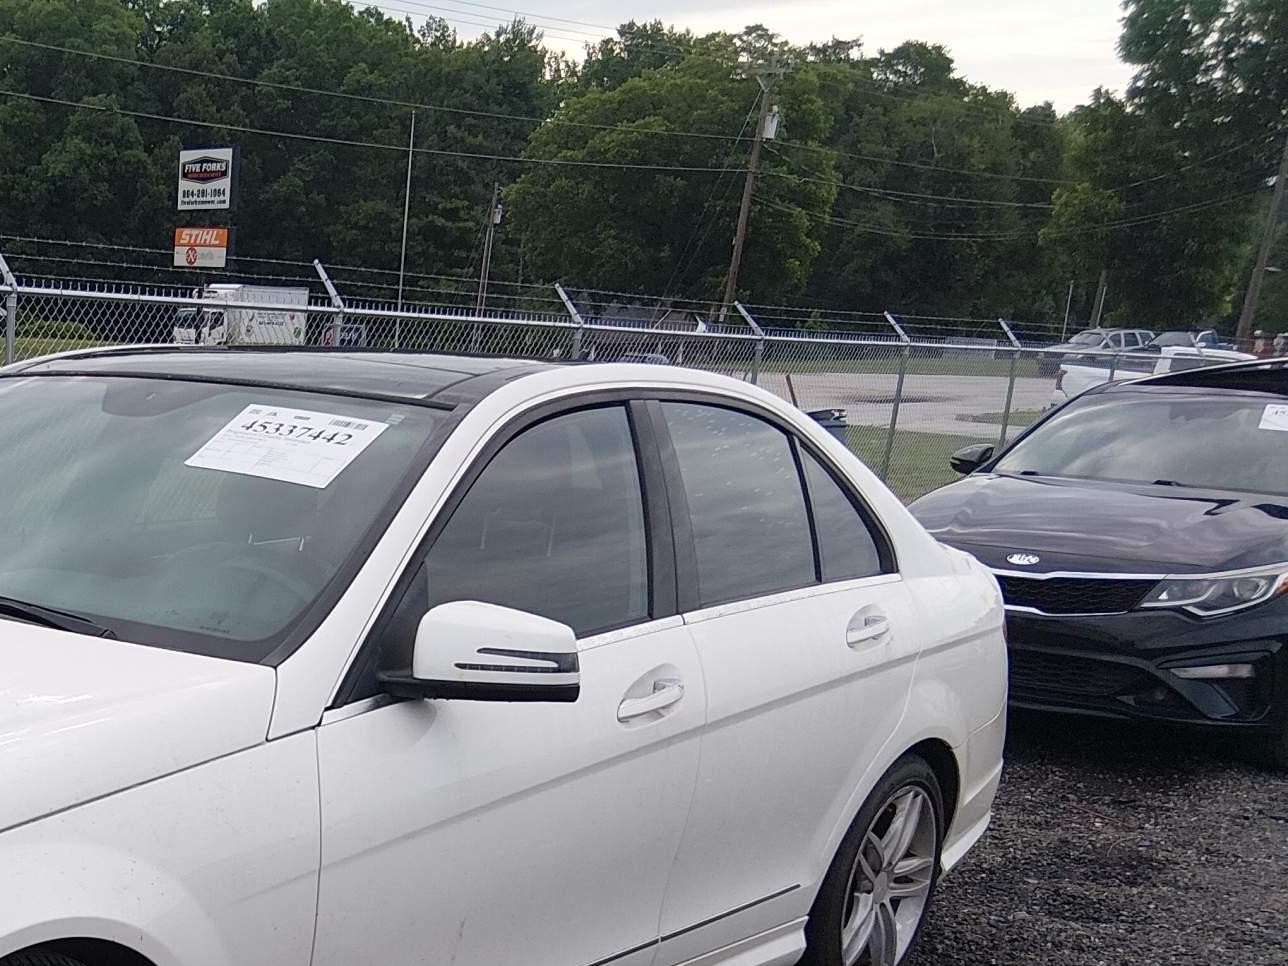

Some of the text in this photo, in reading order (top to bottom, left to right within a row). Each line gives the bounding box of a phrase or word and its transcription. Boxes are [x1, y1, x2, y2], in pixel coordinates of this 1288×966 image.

[184, 162, 227, 173] FIVE FORKS
[179, 230, 220, 245] STIHL
[240, 419, 353, 446] 45337442
